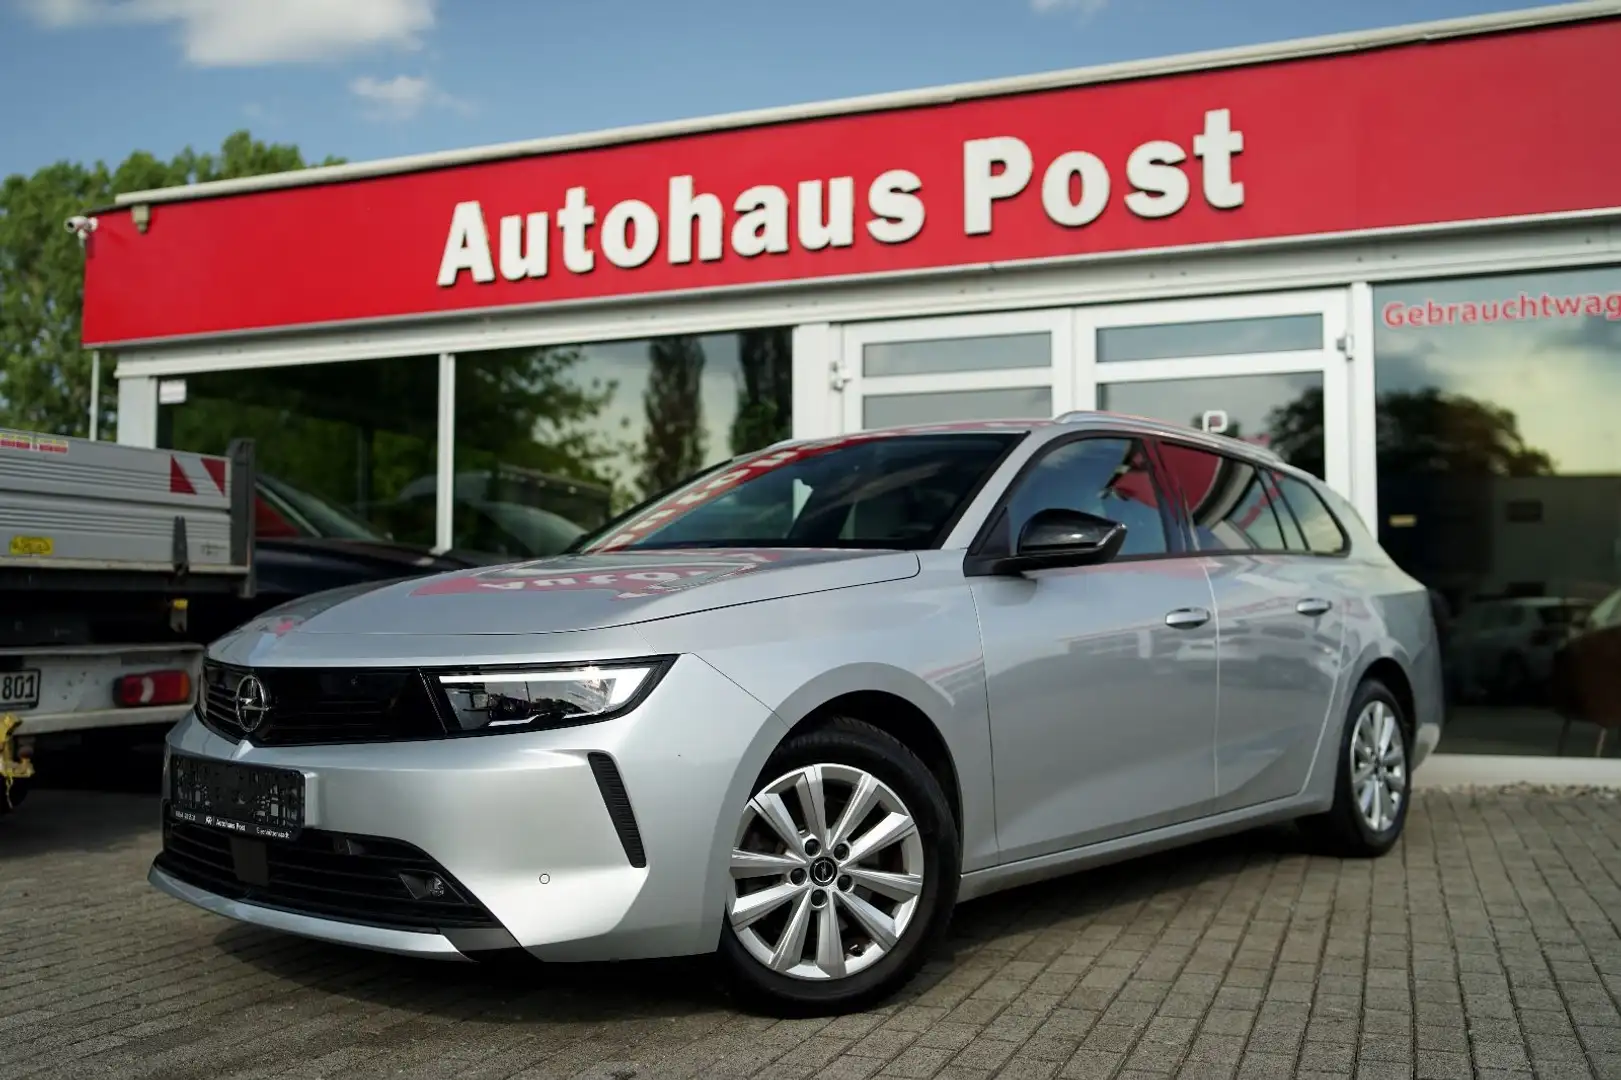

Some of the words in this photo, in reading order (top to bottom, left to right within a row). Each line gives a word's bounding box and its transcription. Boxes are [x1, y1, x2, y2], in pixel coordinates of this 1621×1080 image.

[436, 170, 926, 287] Autohaus
[963, 108, 1246, 236] Post
[1383, 293, 1621, 329] Gebrauchtwag
[2, 675, 35, 700] 801
